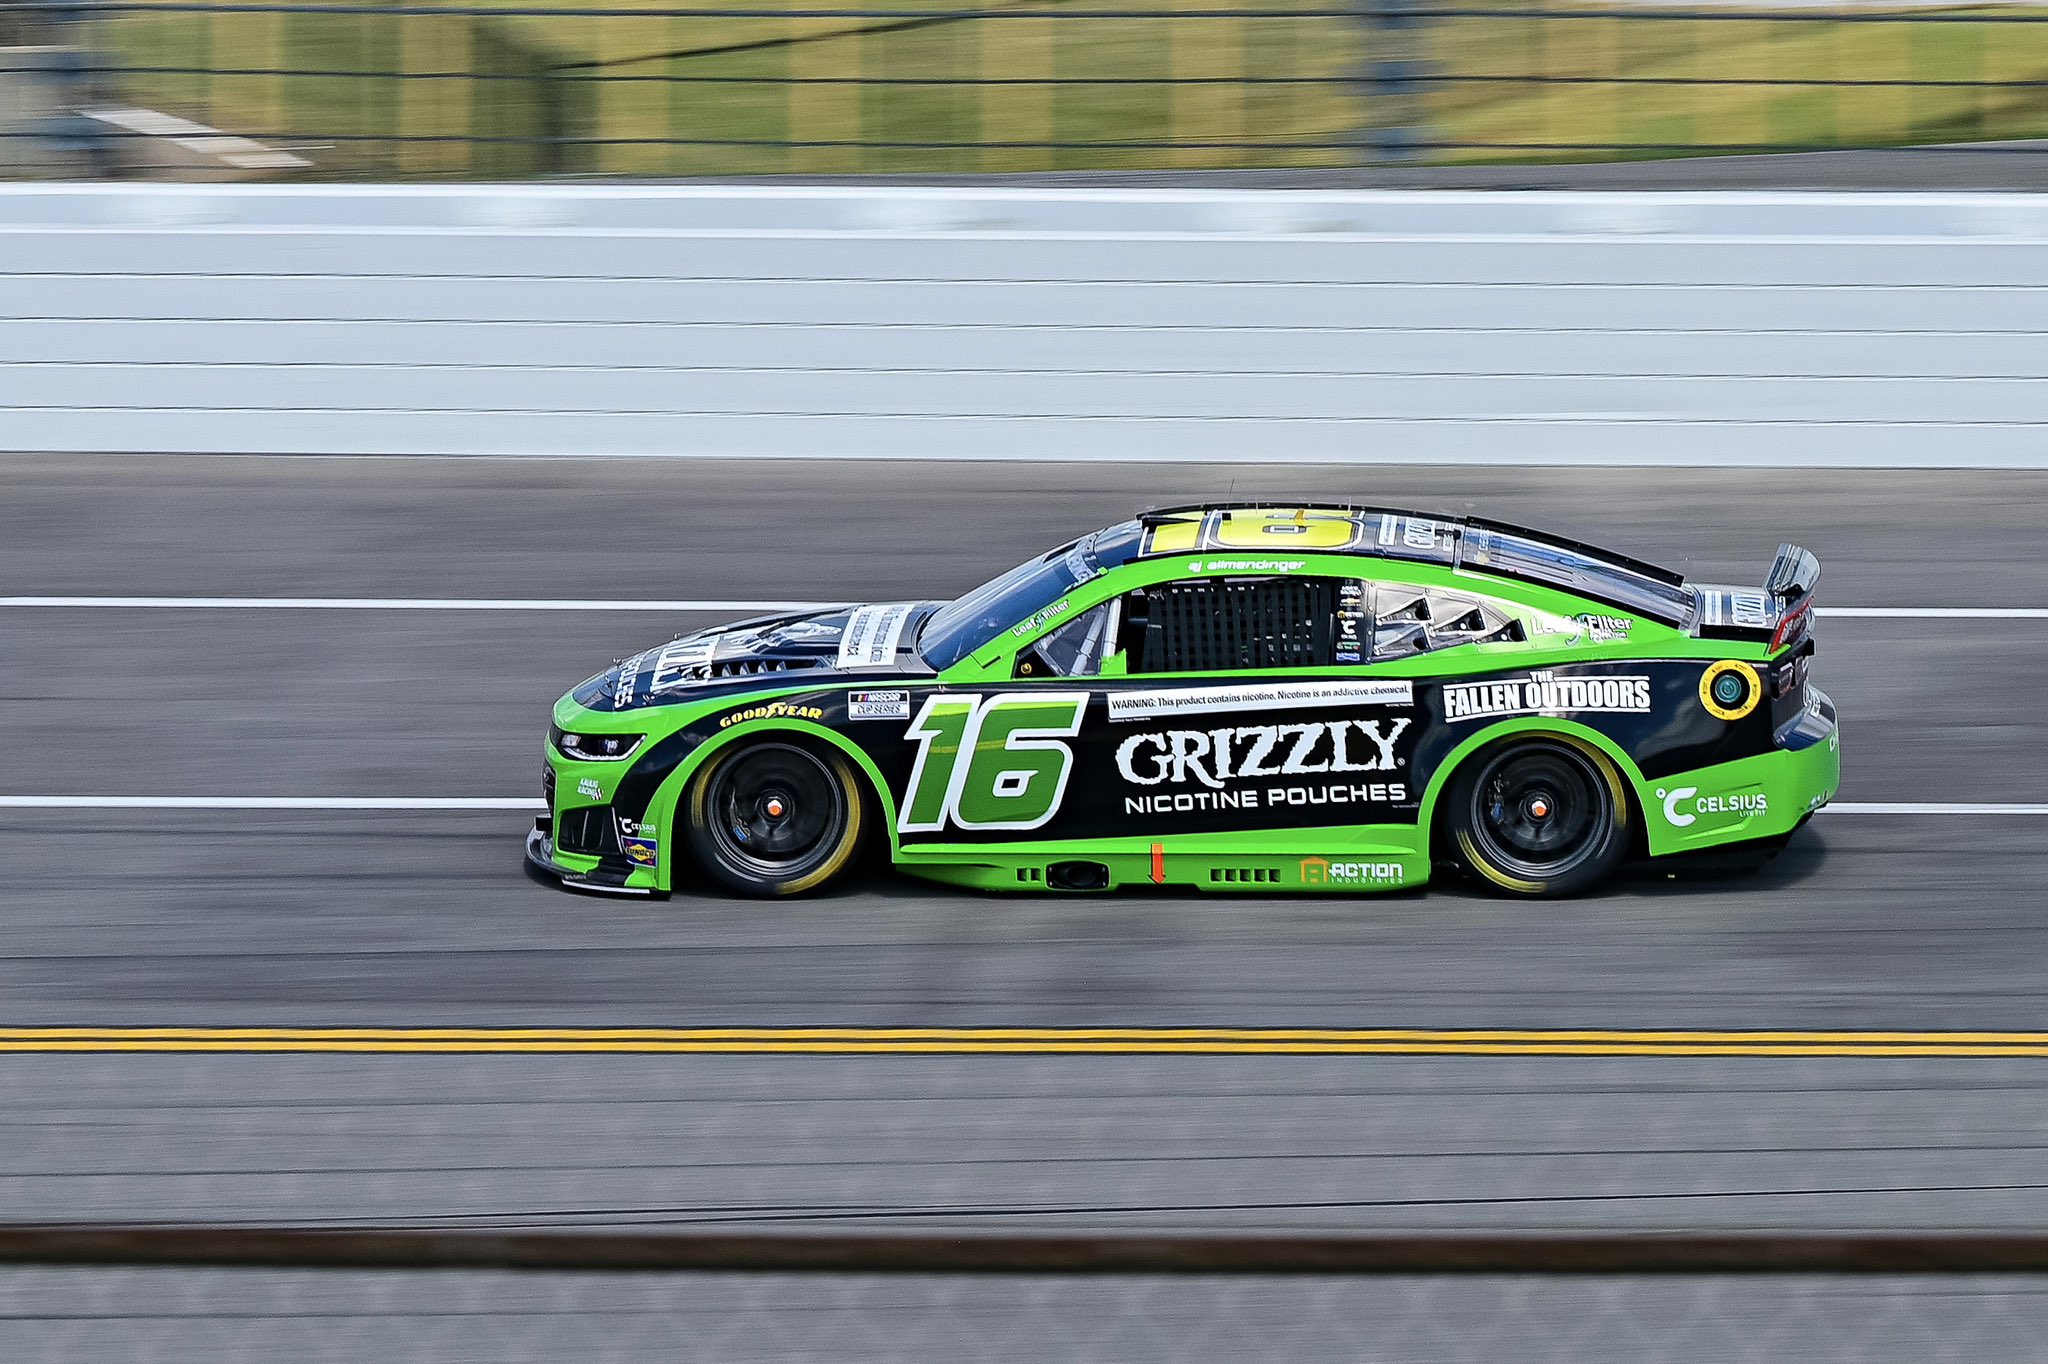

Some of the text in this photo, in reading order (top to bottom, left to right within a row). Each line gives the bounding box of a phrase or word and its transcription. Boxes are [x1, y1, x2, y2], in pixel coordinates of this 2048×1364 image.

[1207, 560, 1306, 572] allmendinger
[1011, 617, 1036, 637] Leaf
[1586, 614, 1633, 631] Filter
[1530, 670, 1555, 682] THE
[1112, 697, 1156, 710] WARNING:
[1158, 696, 1174, 707] This
[1176, 695, 1206, 708] product
[1207, 692, 1241, 704] contains
[1242, 690, 1275, 702] nicotine.
[1277, 689, 1311, 700] Nicotine
[1313, 688, 1320, 697] is
[1321, 689, 1331, 697] an
[1333, 687, 1369, 696] addictive
[1443, 680, 1651, 717] FALLEN OUTDOORS
[719, 701, 823, 727] GOODYEAR
[897, 691, 1091, 833] 16
[1115, 717, 1412, 789] GRIZZLY
[1125, 783, 1407, 814] NICOTINE POUCHES
[1696, 793, 1767, 813] CELSIUS
[1329, 863, 1403, 878] ACTION
[1331, 877, 1404, 885] INDUSTRIES
